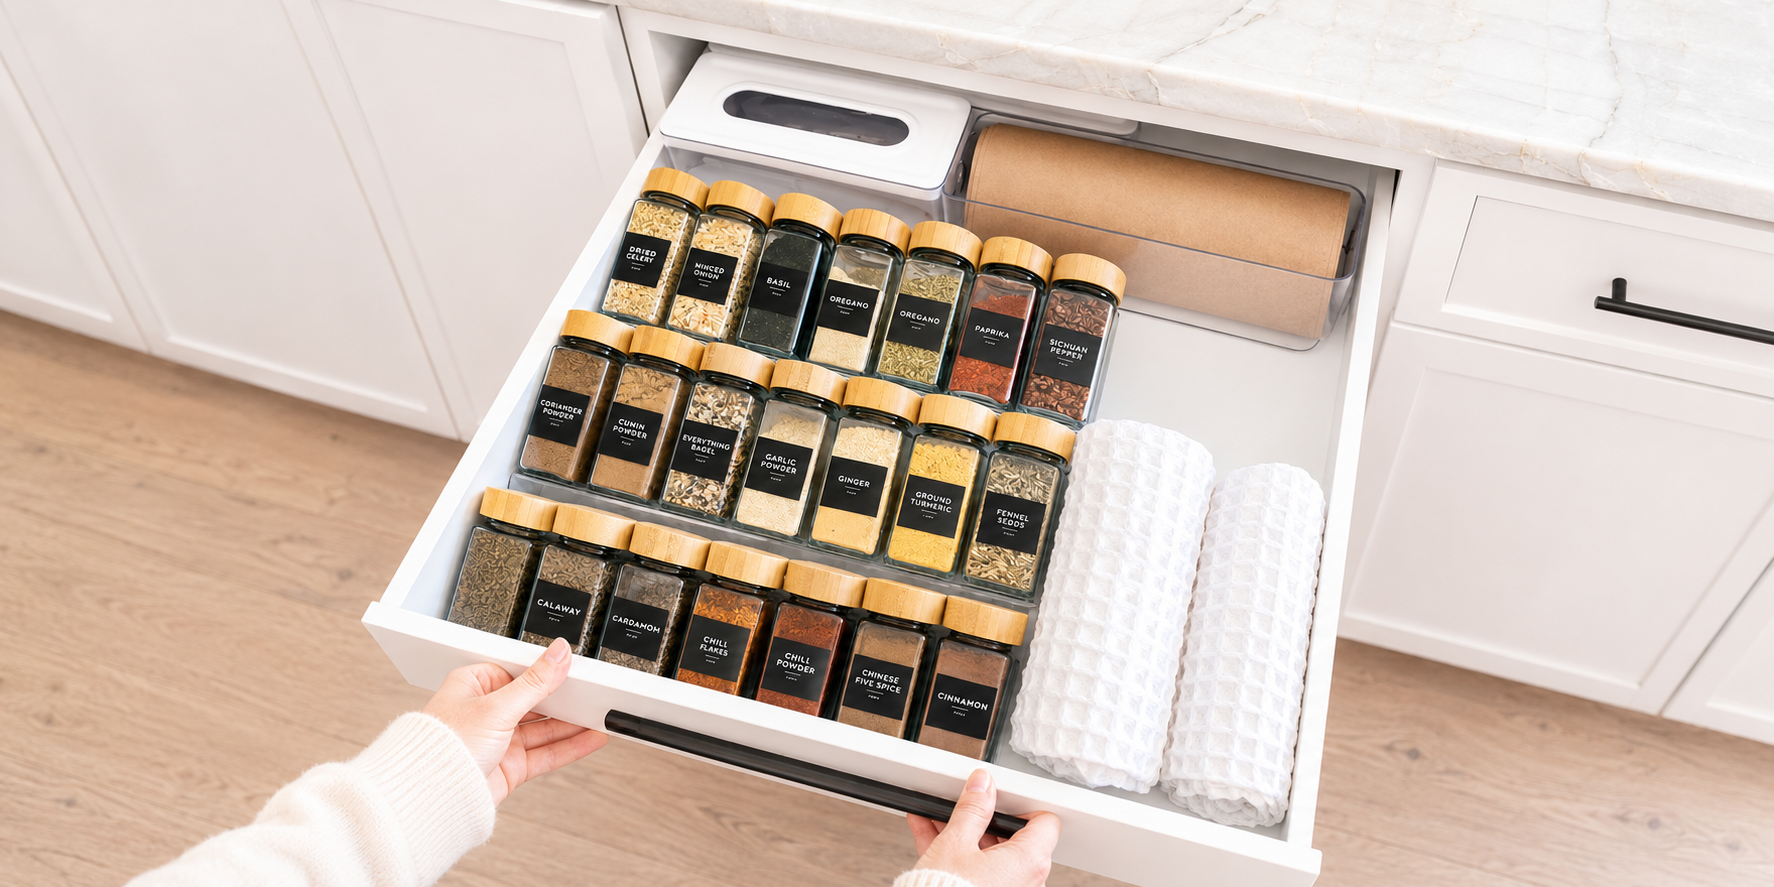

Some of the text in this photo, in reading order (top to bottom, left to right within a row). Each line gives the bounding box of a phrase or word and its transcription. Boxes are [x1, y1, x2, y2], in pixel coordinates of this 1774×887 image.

[693, 269, 720, 280] ONION
[766, 277, 791, 289] BASIL
[829, 295, 869, 309] OREGANO
[899, 310, 940, 325] OREGANO
[975, 325, 1010, 339] PAPRIKA
[1049, 338, 1089, 354] SICHUAN
[1050, 346, 1083, 360] PEPPER
[540, 399, 583, 415] CORIANDER
[542, 407, 574, 421] POWDER
[612, 425, 648, 440] POWDER
[682, 433, 731, 451] EVERYTHING
[690, 444, 716, 456] BAGEL
[765, 453, 797, 467] GARLIC
[760, 460, 797, 475] POWDER
[838, 475, 871, 488] GINGER
[915, 491, 952, 505] GROUND
[910, 498, 953, 513] TURMERIC
[996, 508, 1030, 522] FENNEL
[537, 599, 581, 616] CALAWAY
[612, 615, 661, 634] CARDAMOM
[703, 636, 728, 649] CHILL
[699, 643, 729, 657] FLAKES
[784, 652, 810, 665] CHILL
[776, 659, 816, 675] POWDER
[862, 669, 900, 685] CHINESE
[855, 677, 902, 695] FIVE SPICE
[937, 692, 989, 711] CINNAMON
